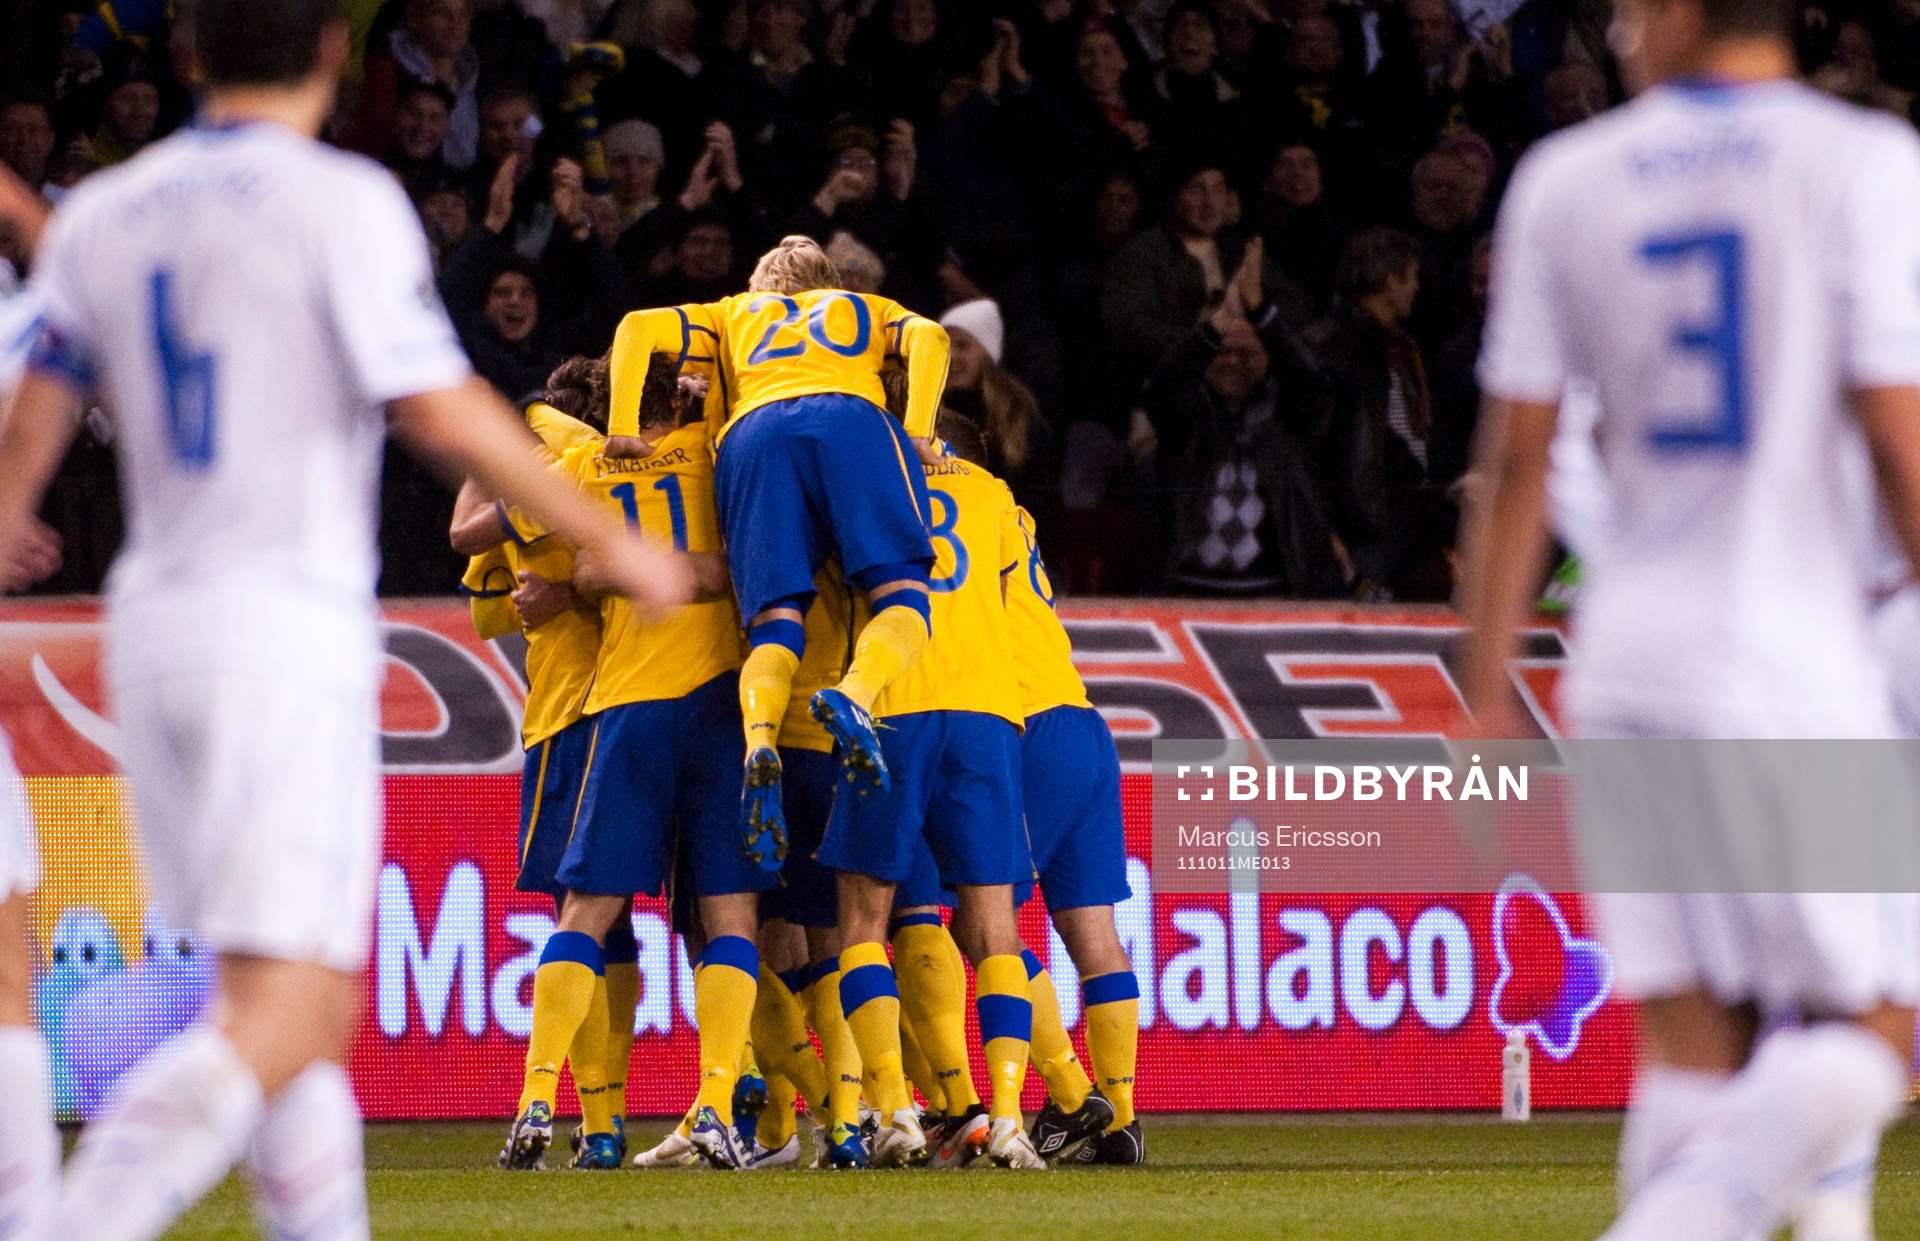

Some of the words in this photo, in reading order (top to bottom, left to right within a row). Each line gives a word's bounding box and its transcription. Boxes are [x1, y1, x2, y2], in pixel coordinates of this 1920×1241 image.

[747, 293, 871, 365] 20
[1640, 228, 1744, 453] 3
[609, 472, 688, 553] 11
[1047, 818, 1477, 1033] Malaco
